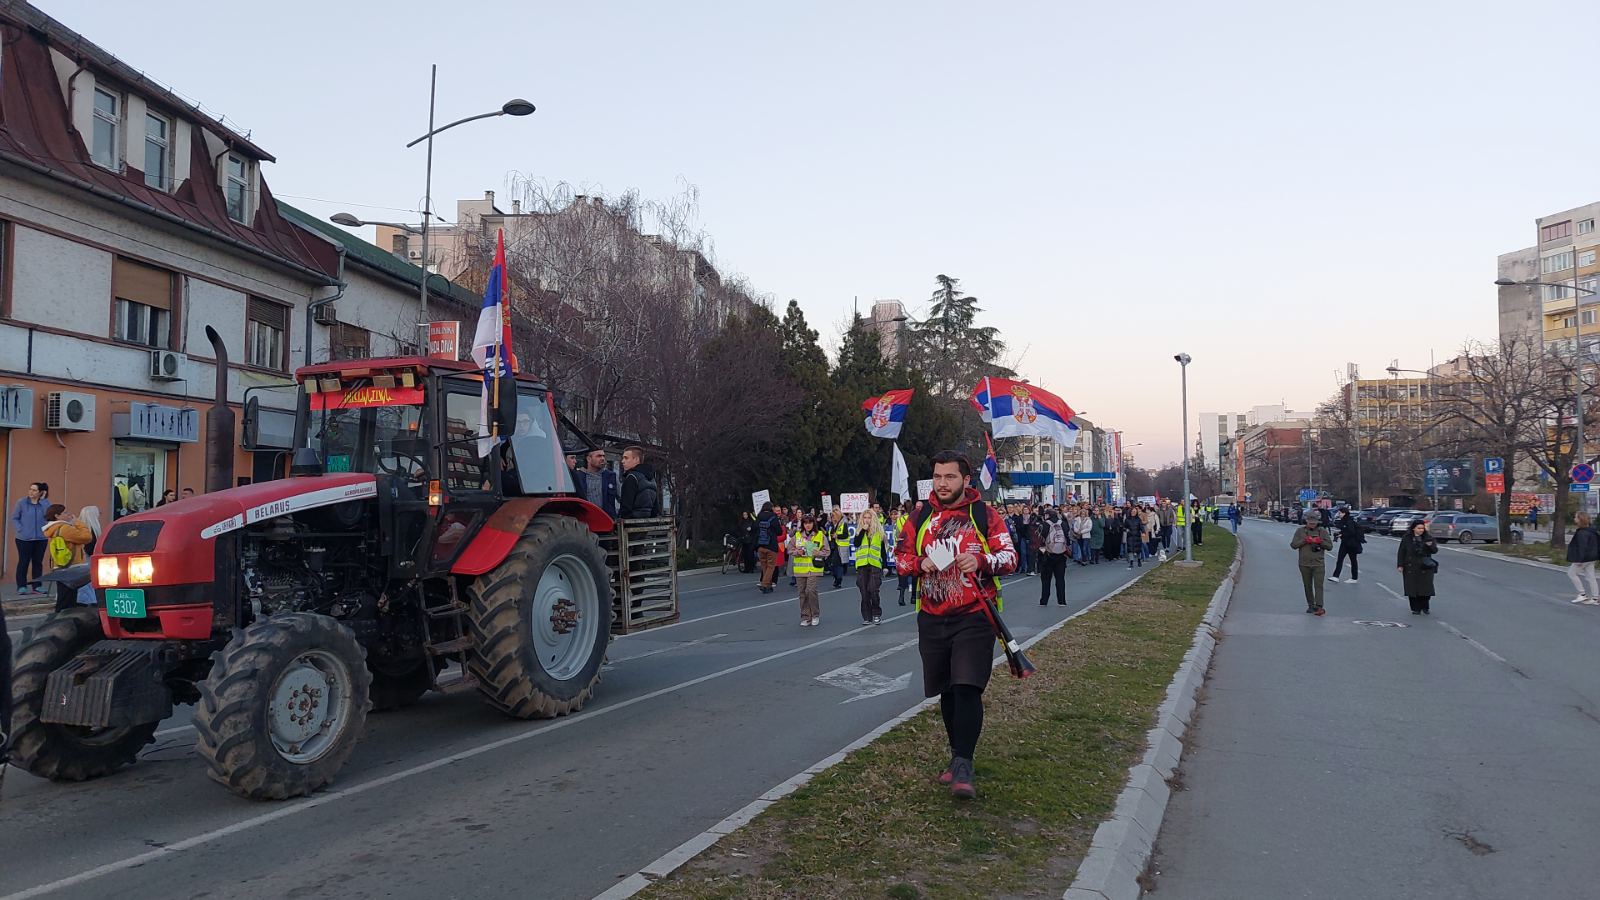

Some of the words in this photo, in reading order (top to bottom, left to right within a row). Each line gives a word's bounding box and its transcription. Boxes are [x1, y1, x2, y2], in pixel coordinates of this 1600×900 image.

[1488, 460, 1498, 471] P
[254, 500, 290, 519] BELARUS
[113, 599, 138, 615] 5302
